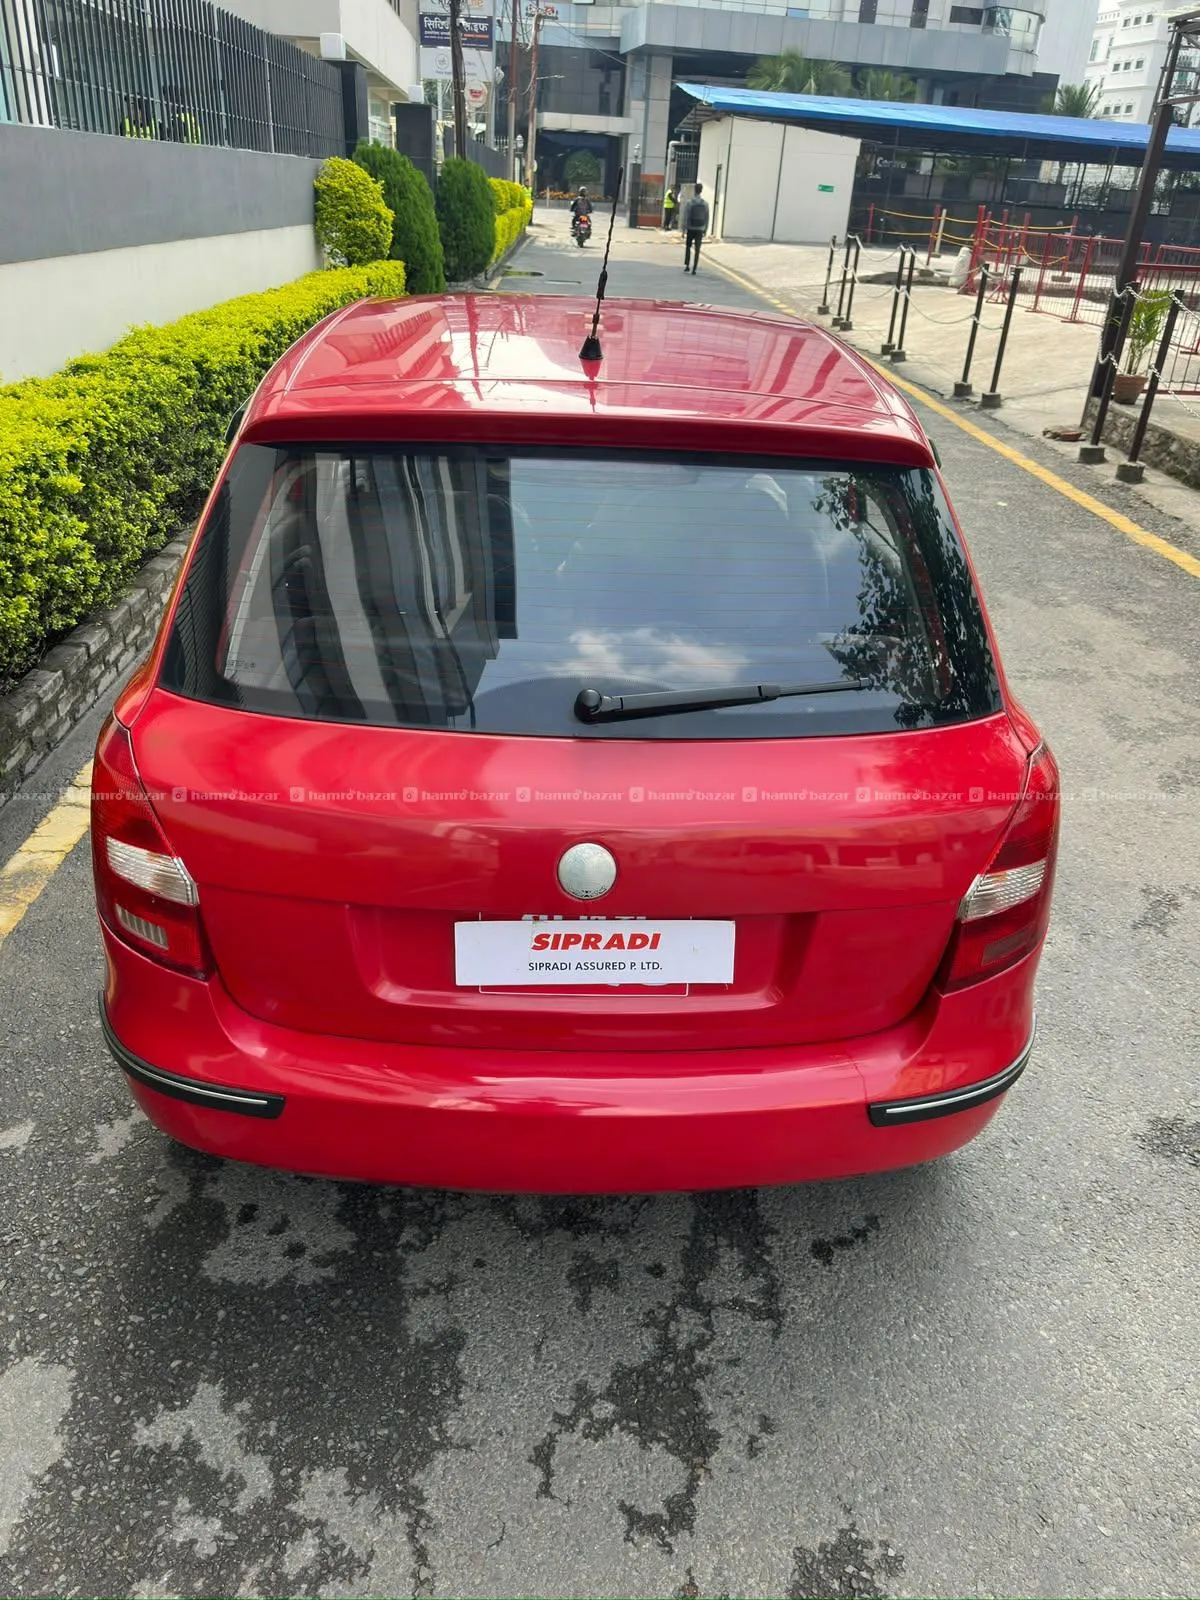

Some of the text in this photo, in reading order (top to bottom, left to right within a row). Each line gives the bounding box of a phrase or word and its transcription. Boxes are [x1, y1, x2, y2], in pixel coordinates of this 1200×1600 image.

[531, 932, 662, 951] SIPRADI
[528, 961, 663, 971] SIPRADI ASSURED P. LTD.
